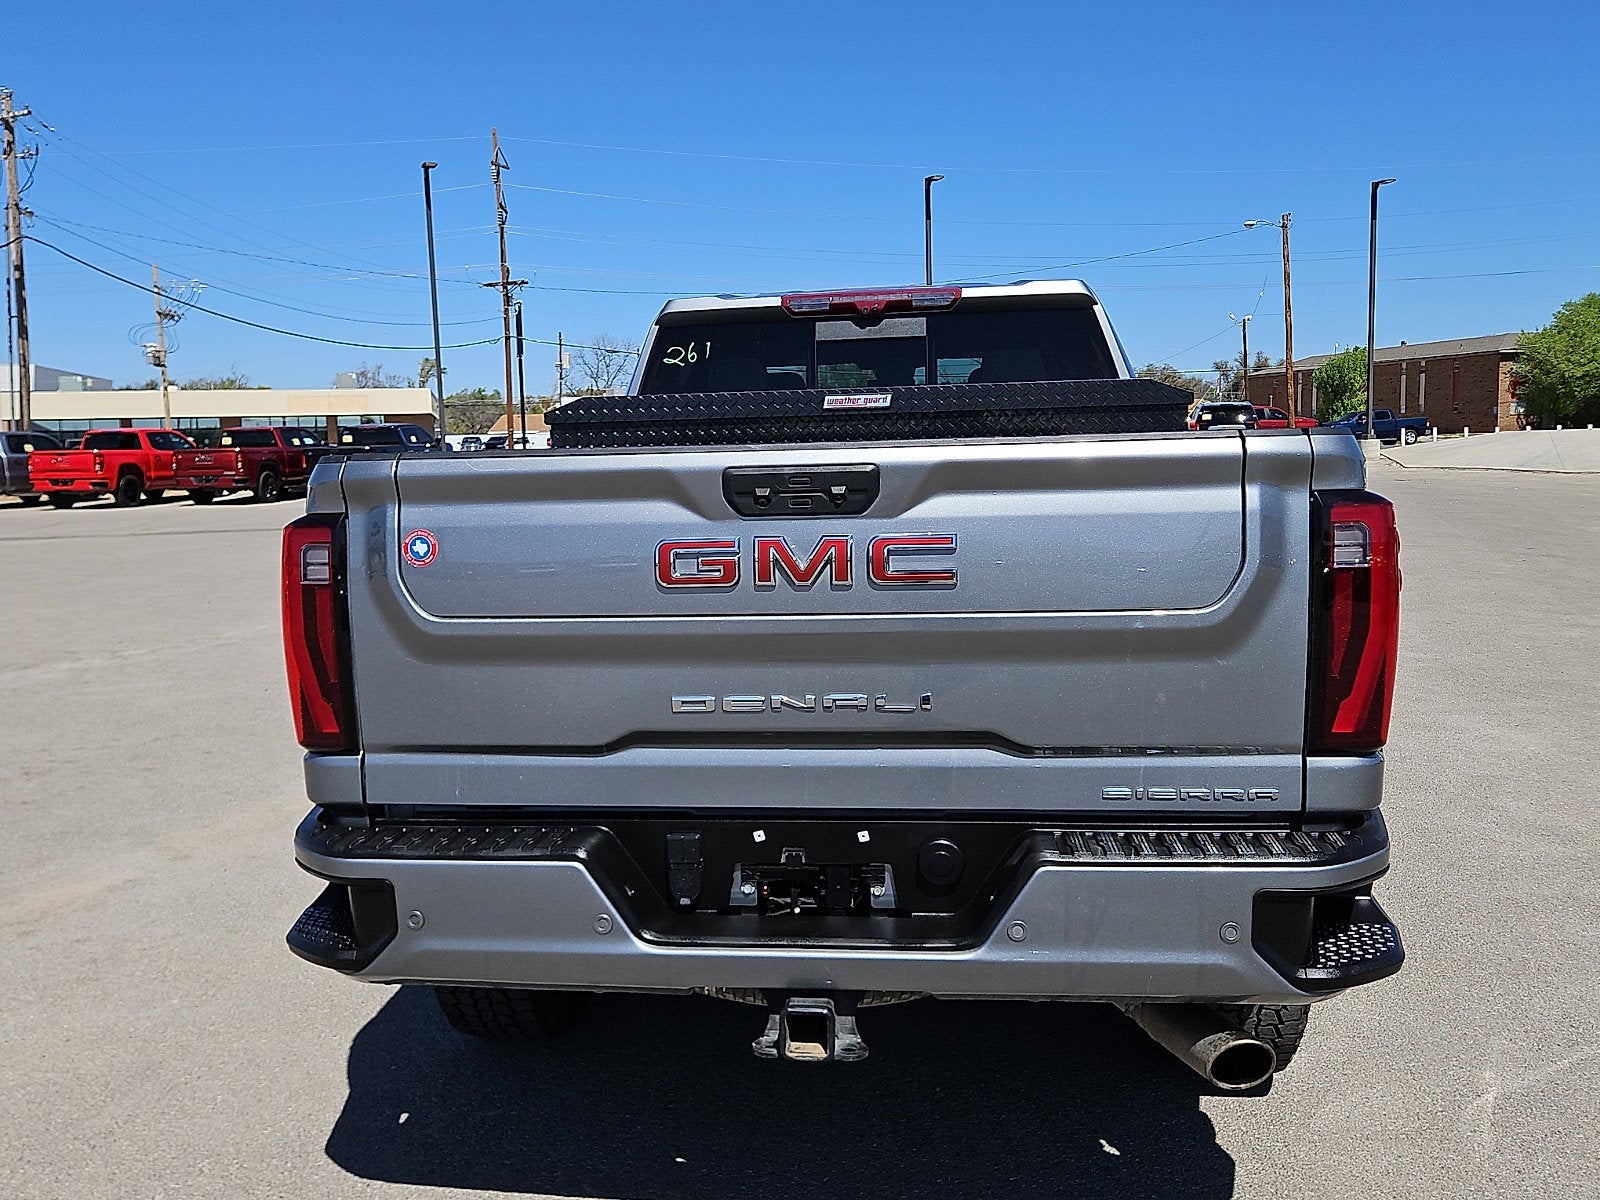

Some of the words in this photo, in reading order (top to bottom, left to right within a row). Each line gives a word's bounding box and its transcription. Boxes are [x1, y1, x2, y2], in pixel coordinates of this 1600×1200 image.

[663, 341, 711, 367] 261
[826, 396, 861, 406] weather
[863, 395, 889, 406] guard
[654, 532, 958, 589] GMC
[671, 692, 933, 712] DENALI
[1102, 786, 1280, 801] SIERRA
